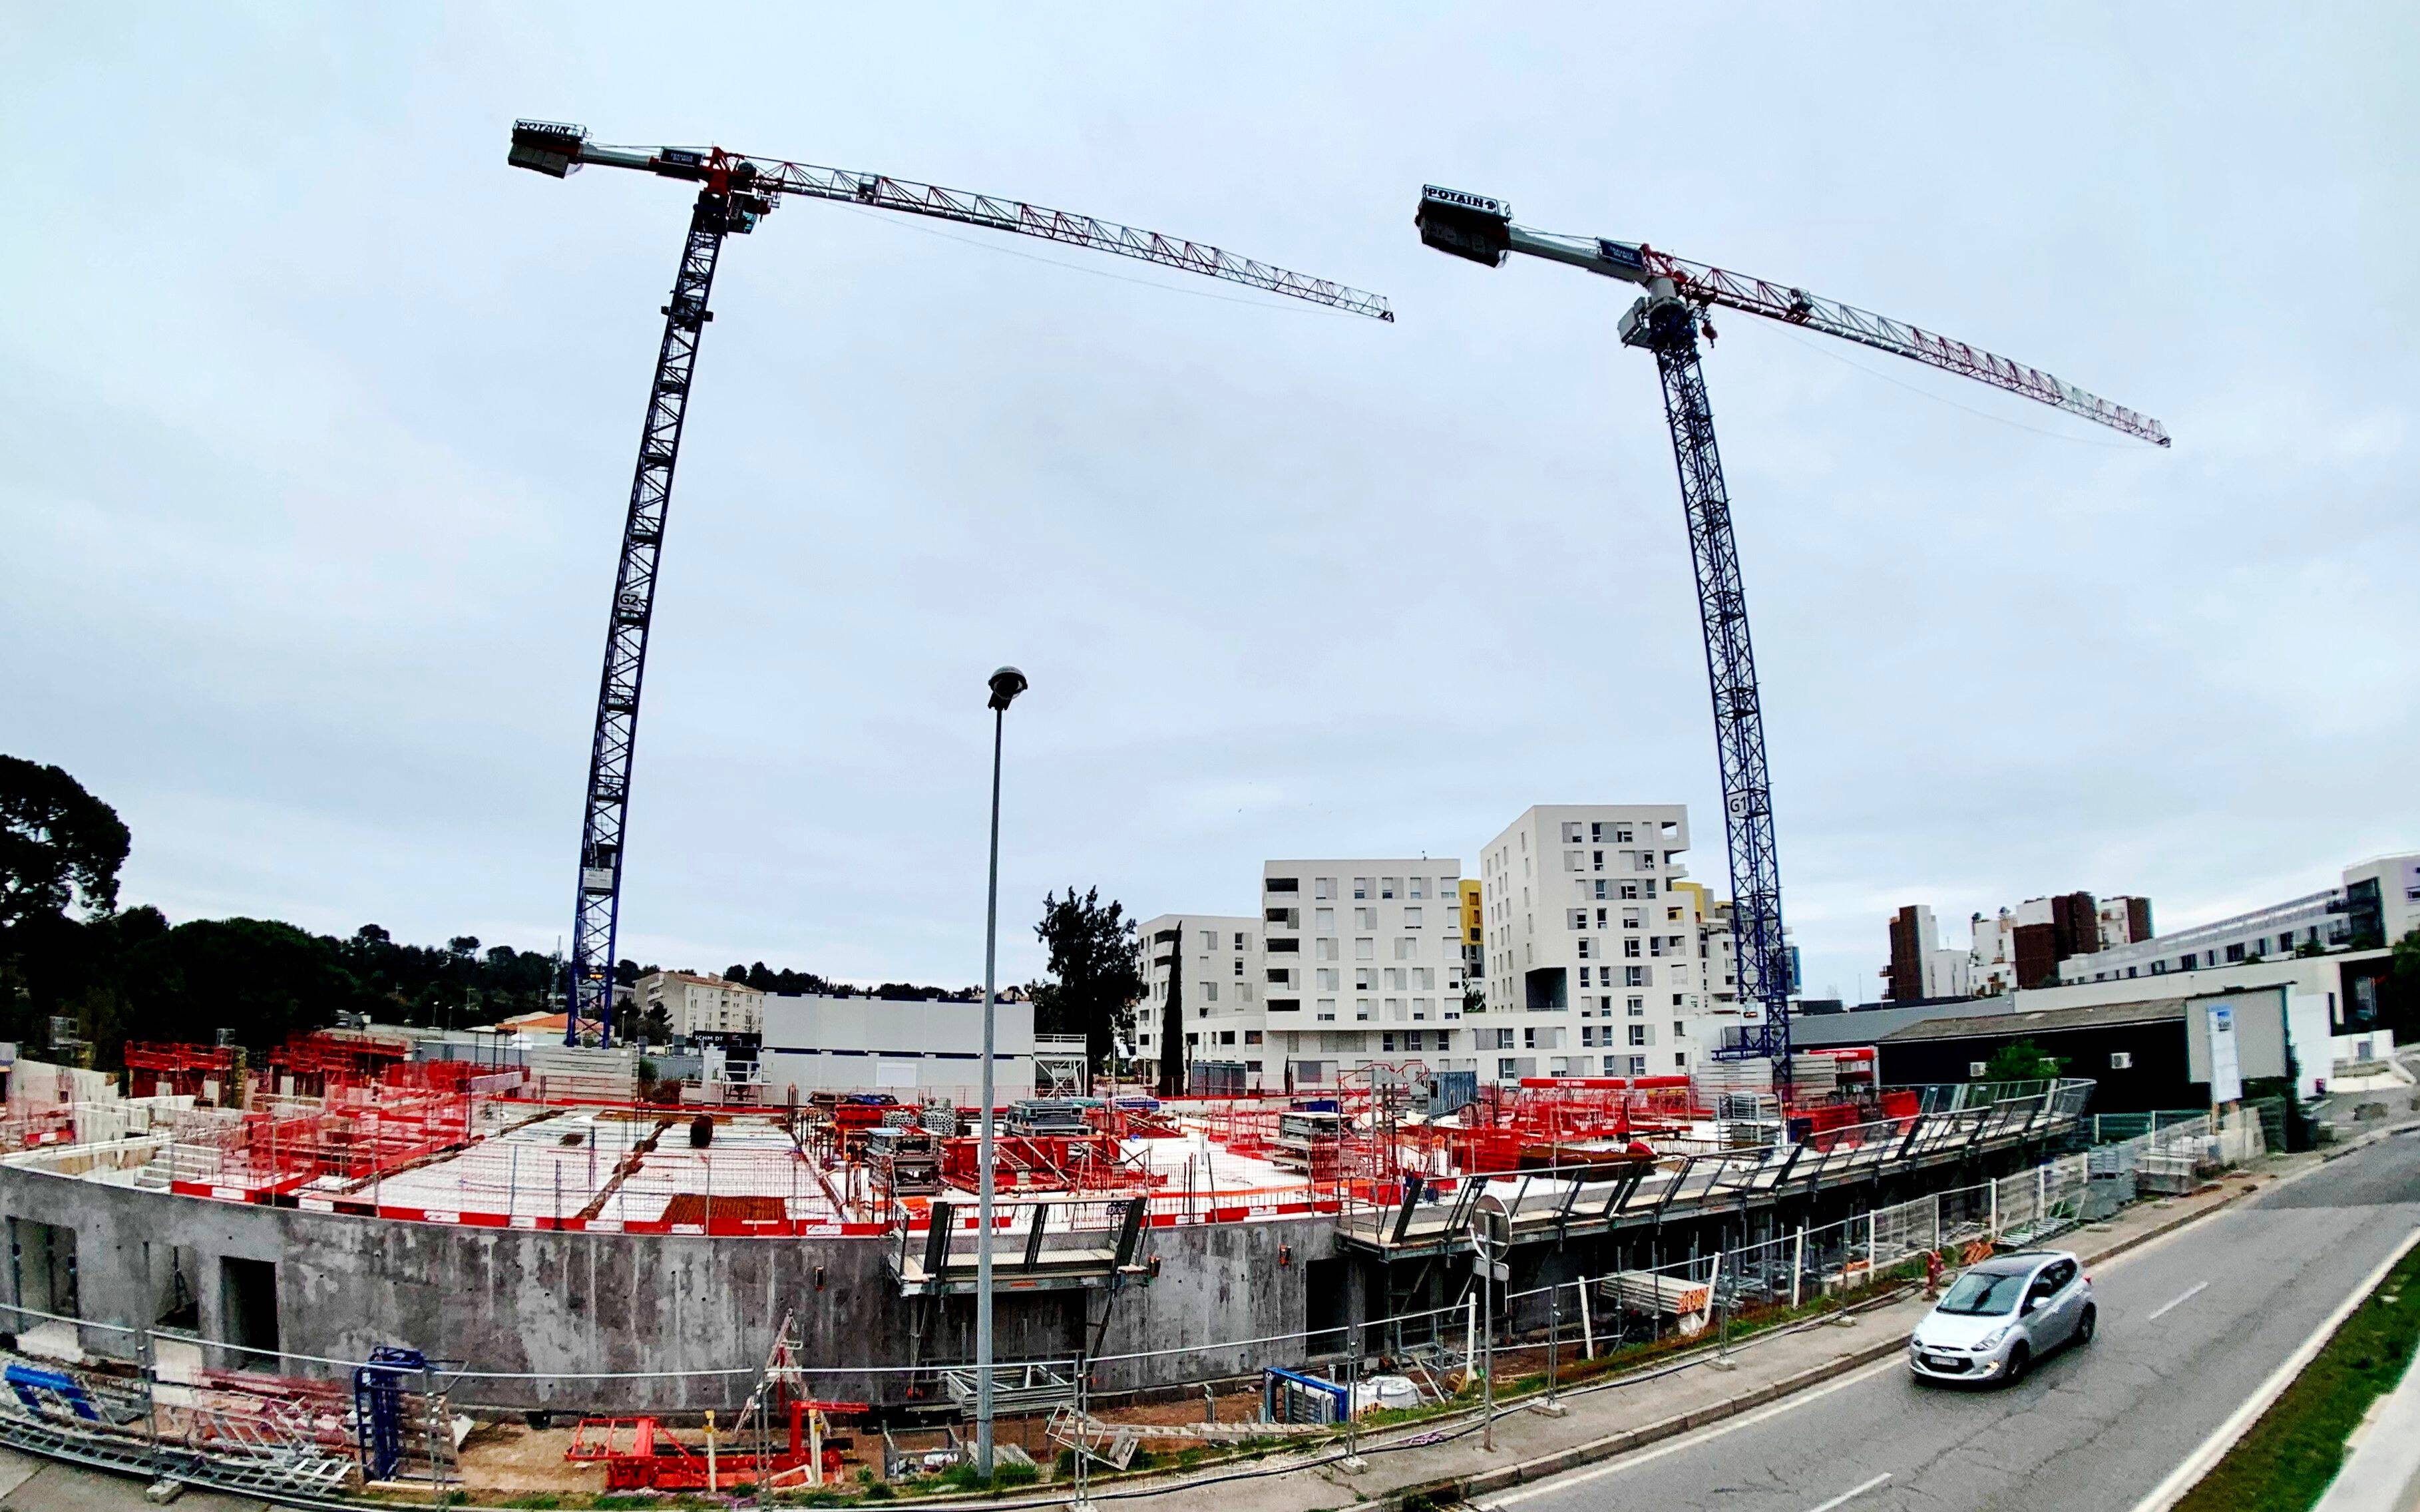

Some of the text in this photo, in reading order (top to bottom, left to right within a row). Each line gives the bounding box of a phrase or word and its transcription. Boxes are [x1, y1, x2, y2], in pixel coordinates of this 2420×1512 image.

[1428, 188, 1484, 208] POTAIN
[619, 594, 639, 606] G2
[1730, 796, 1747, 813] G1
